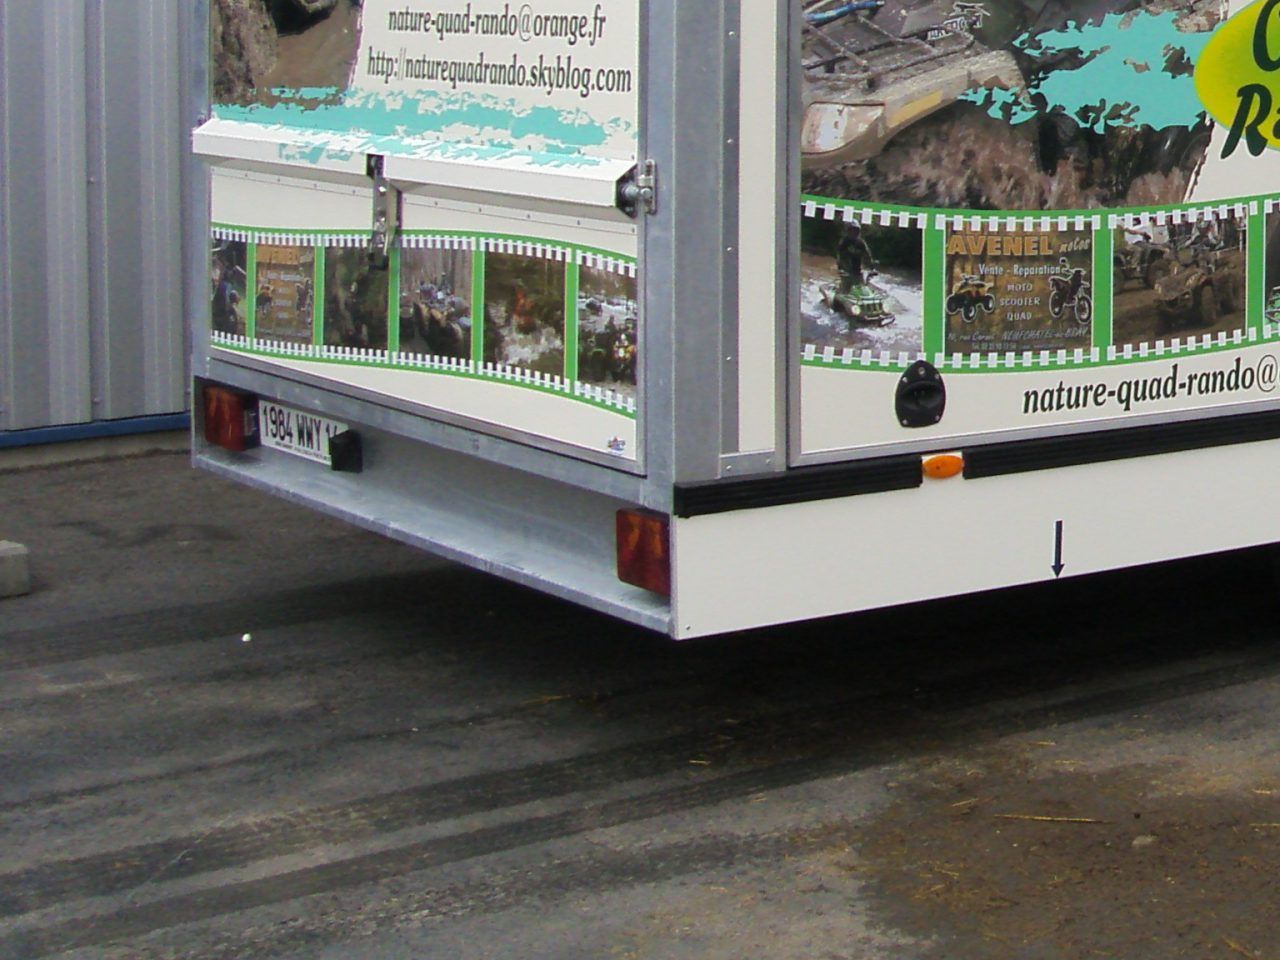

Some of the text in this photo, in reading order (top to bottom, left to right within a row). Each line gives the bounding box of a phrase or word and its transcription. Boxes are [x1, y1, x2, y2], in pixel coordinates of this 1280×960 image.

[388, 2, 607, 46] nature-quad-rando@orange.fr
[368, 46, 632, 98] http://naturequadrando.skyblog.com
[946, 234, 1053, 256] AVENEL
[1006, 311, 1032, 321] QUAD
[264, 405, 294, 444] 1984
[296, 413, 322, 452] WWY
